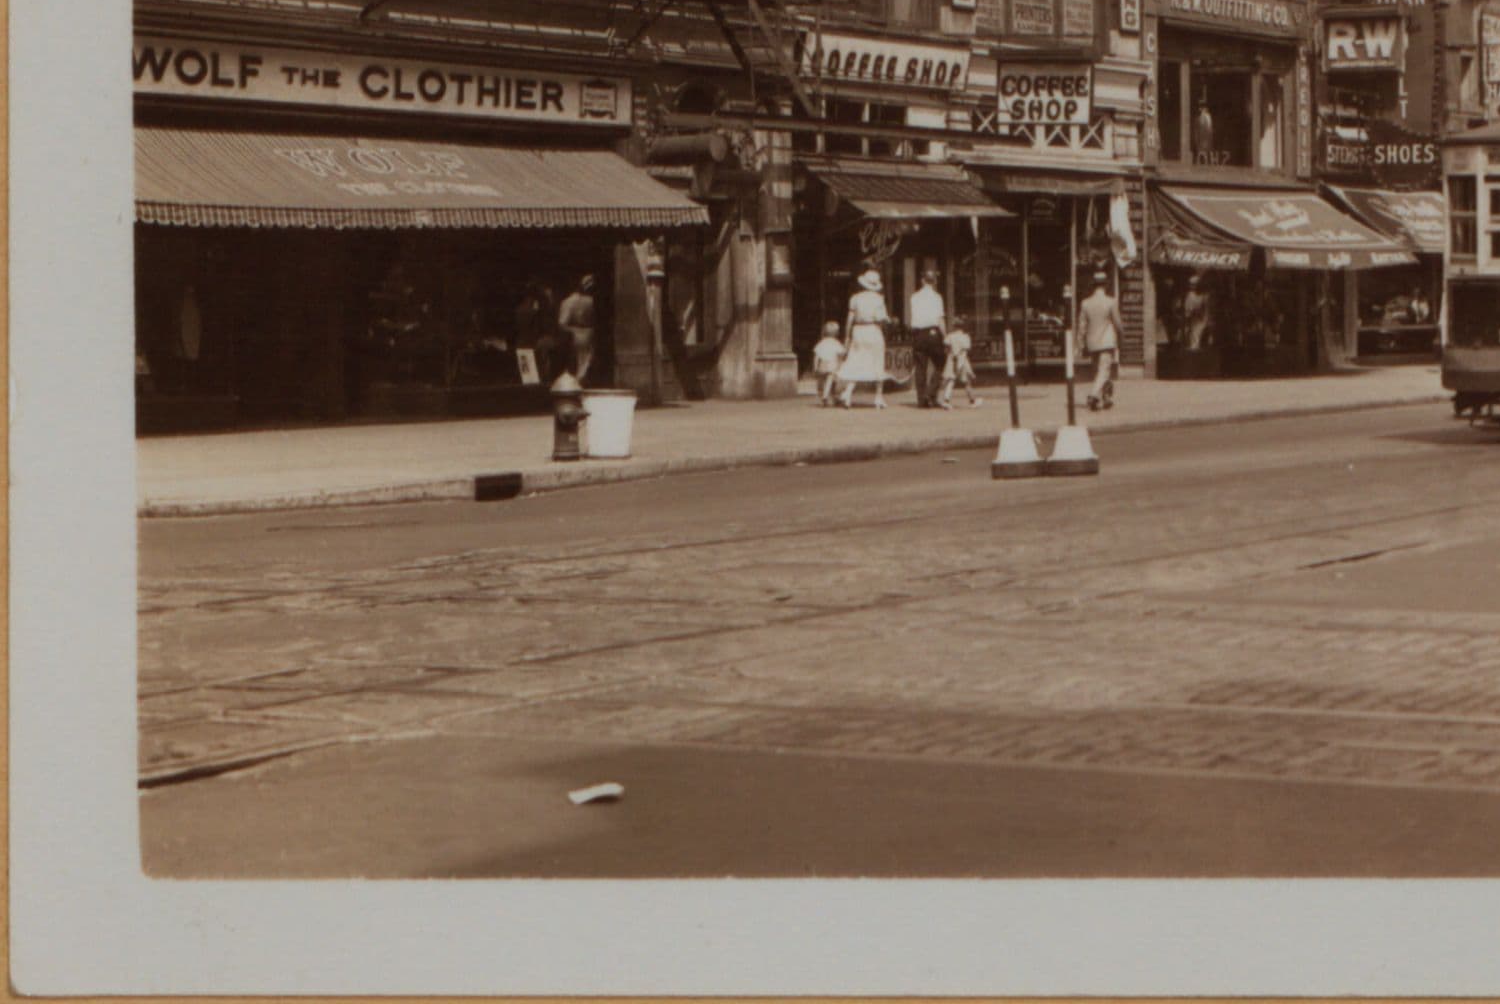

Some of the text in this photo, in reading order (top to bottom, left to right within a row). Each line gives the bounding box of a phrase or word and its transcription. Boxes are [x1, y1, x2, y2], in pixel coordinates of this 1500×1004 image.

[1328, 22, 1397, 60] R-W
[133, 48, 262, 88] WOLF
[281, 66, 340, 88] THE
[359, 65, 565, 112] CLOTHIER
[812, 49, 960, 85] COFFEE SHOP
[1001, 75, 1088, 96] COFFEE
[1011, 99, 1077, 120] SHOP
[1374, 143, 1435, 164] SHOES
